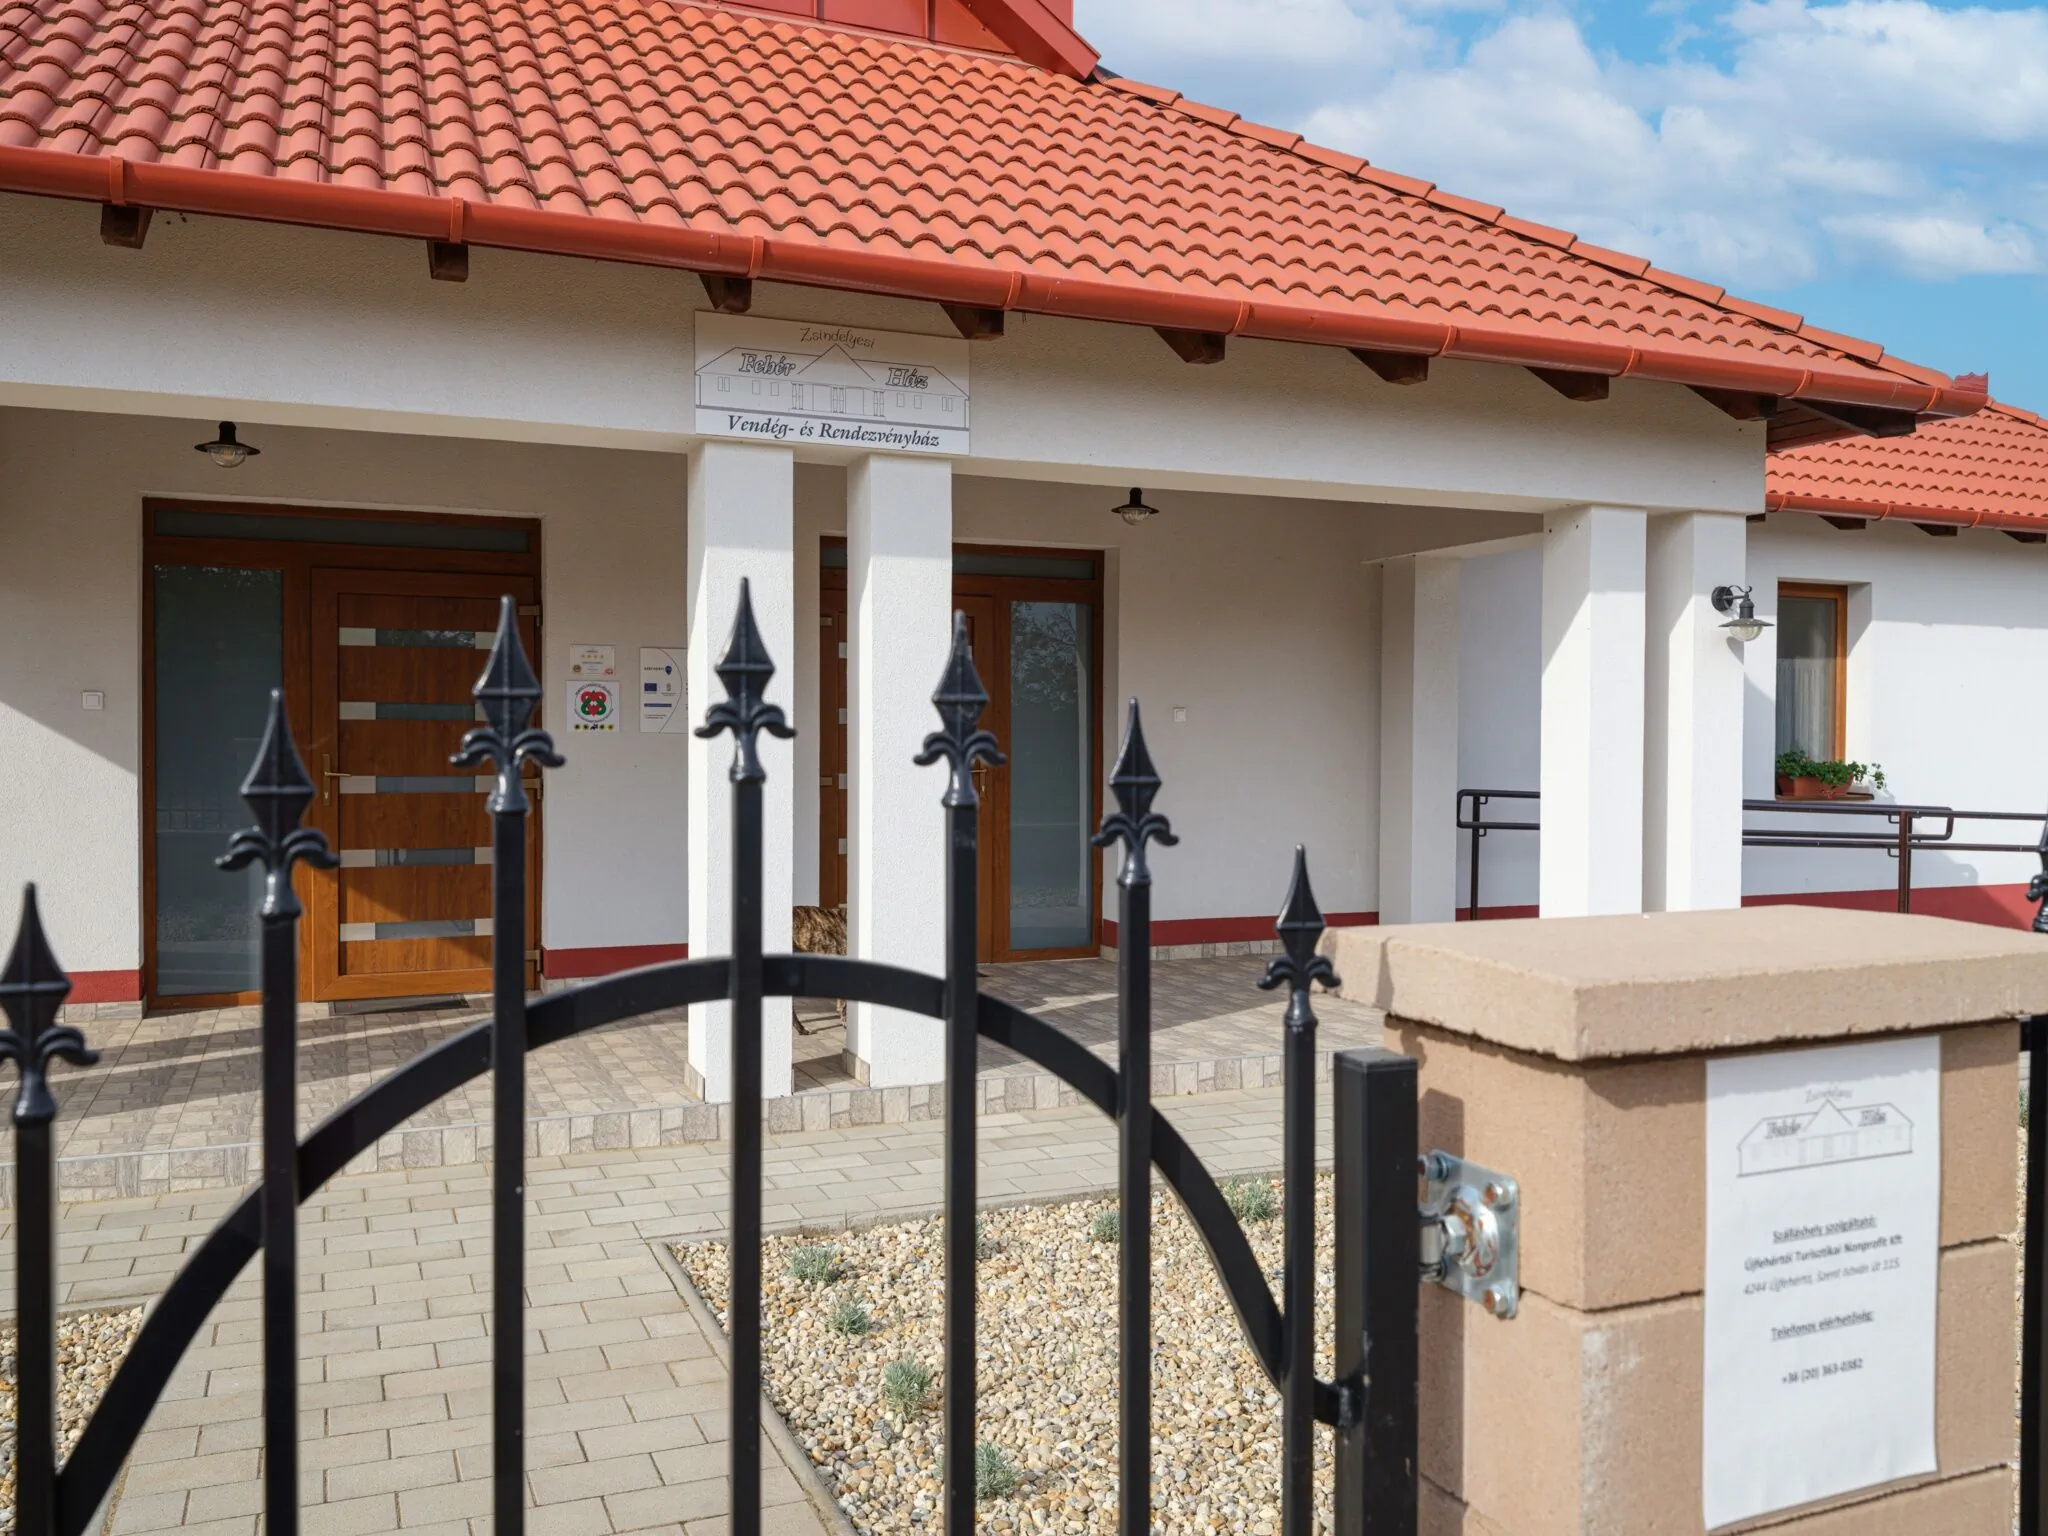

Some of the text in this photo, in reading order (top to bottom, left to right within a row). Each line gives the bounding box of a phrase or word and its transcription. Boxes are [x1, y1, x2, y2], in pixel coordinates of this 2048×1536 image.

[800, 327, 876, 349] Zsindelyesi
[738, 353, 929, 389] Fehér Ház
[727, 414, 940, 449] Vendég- és Rendezvényház
